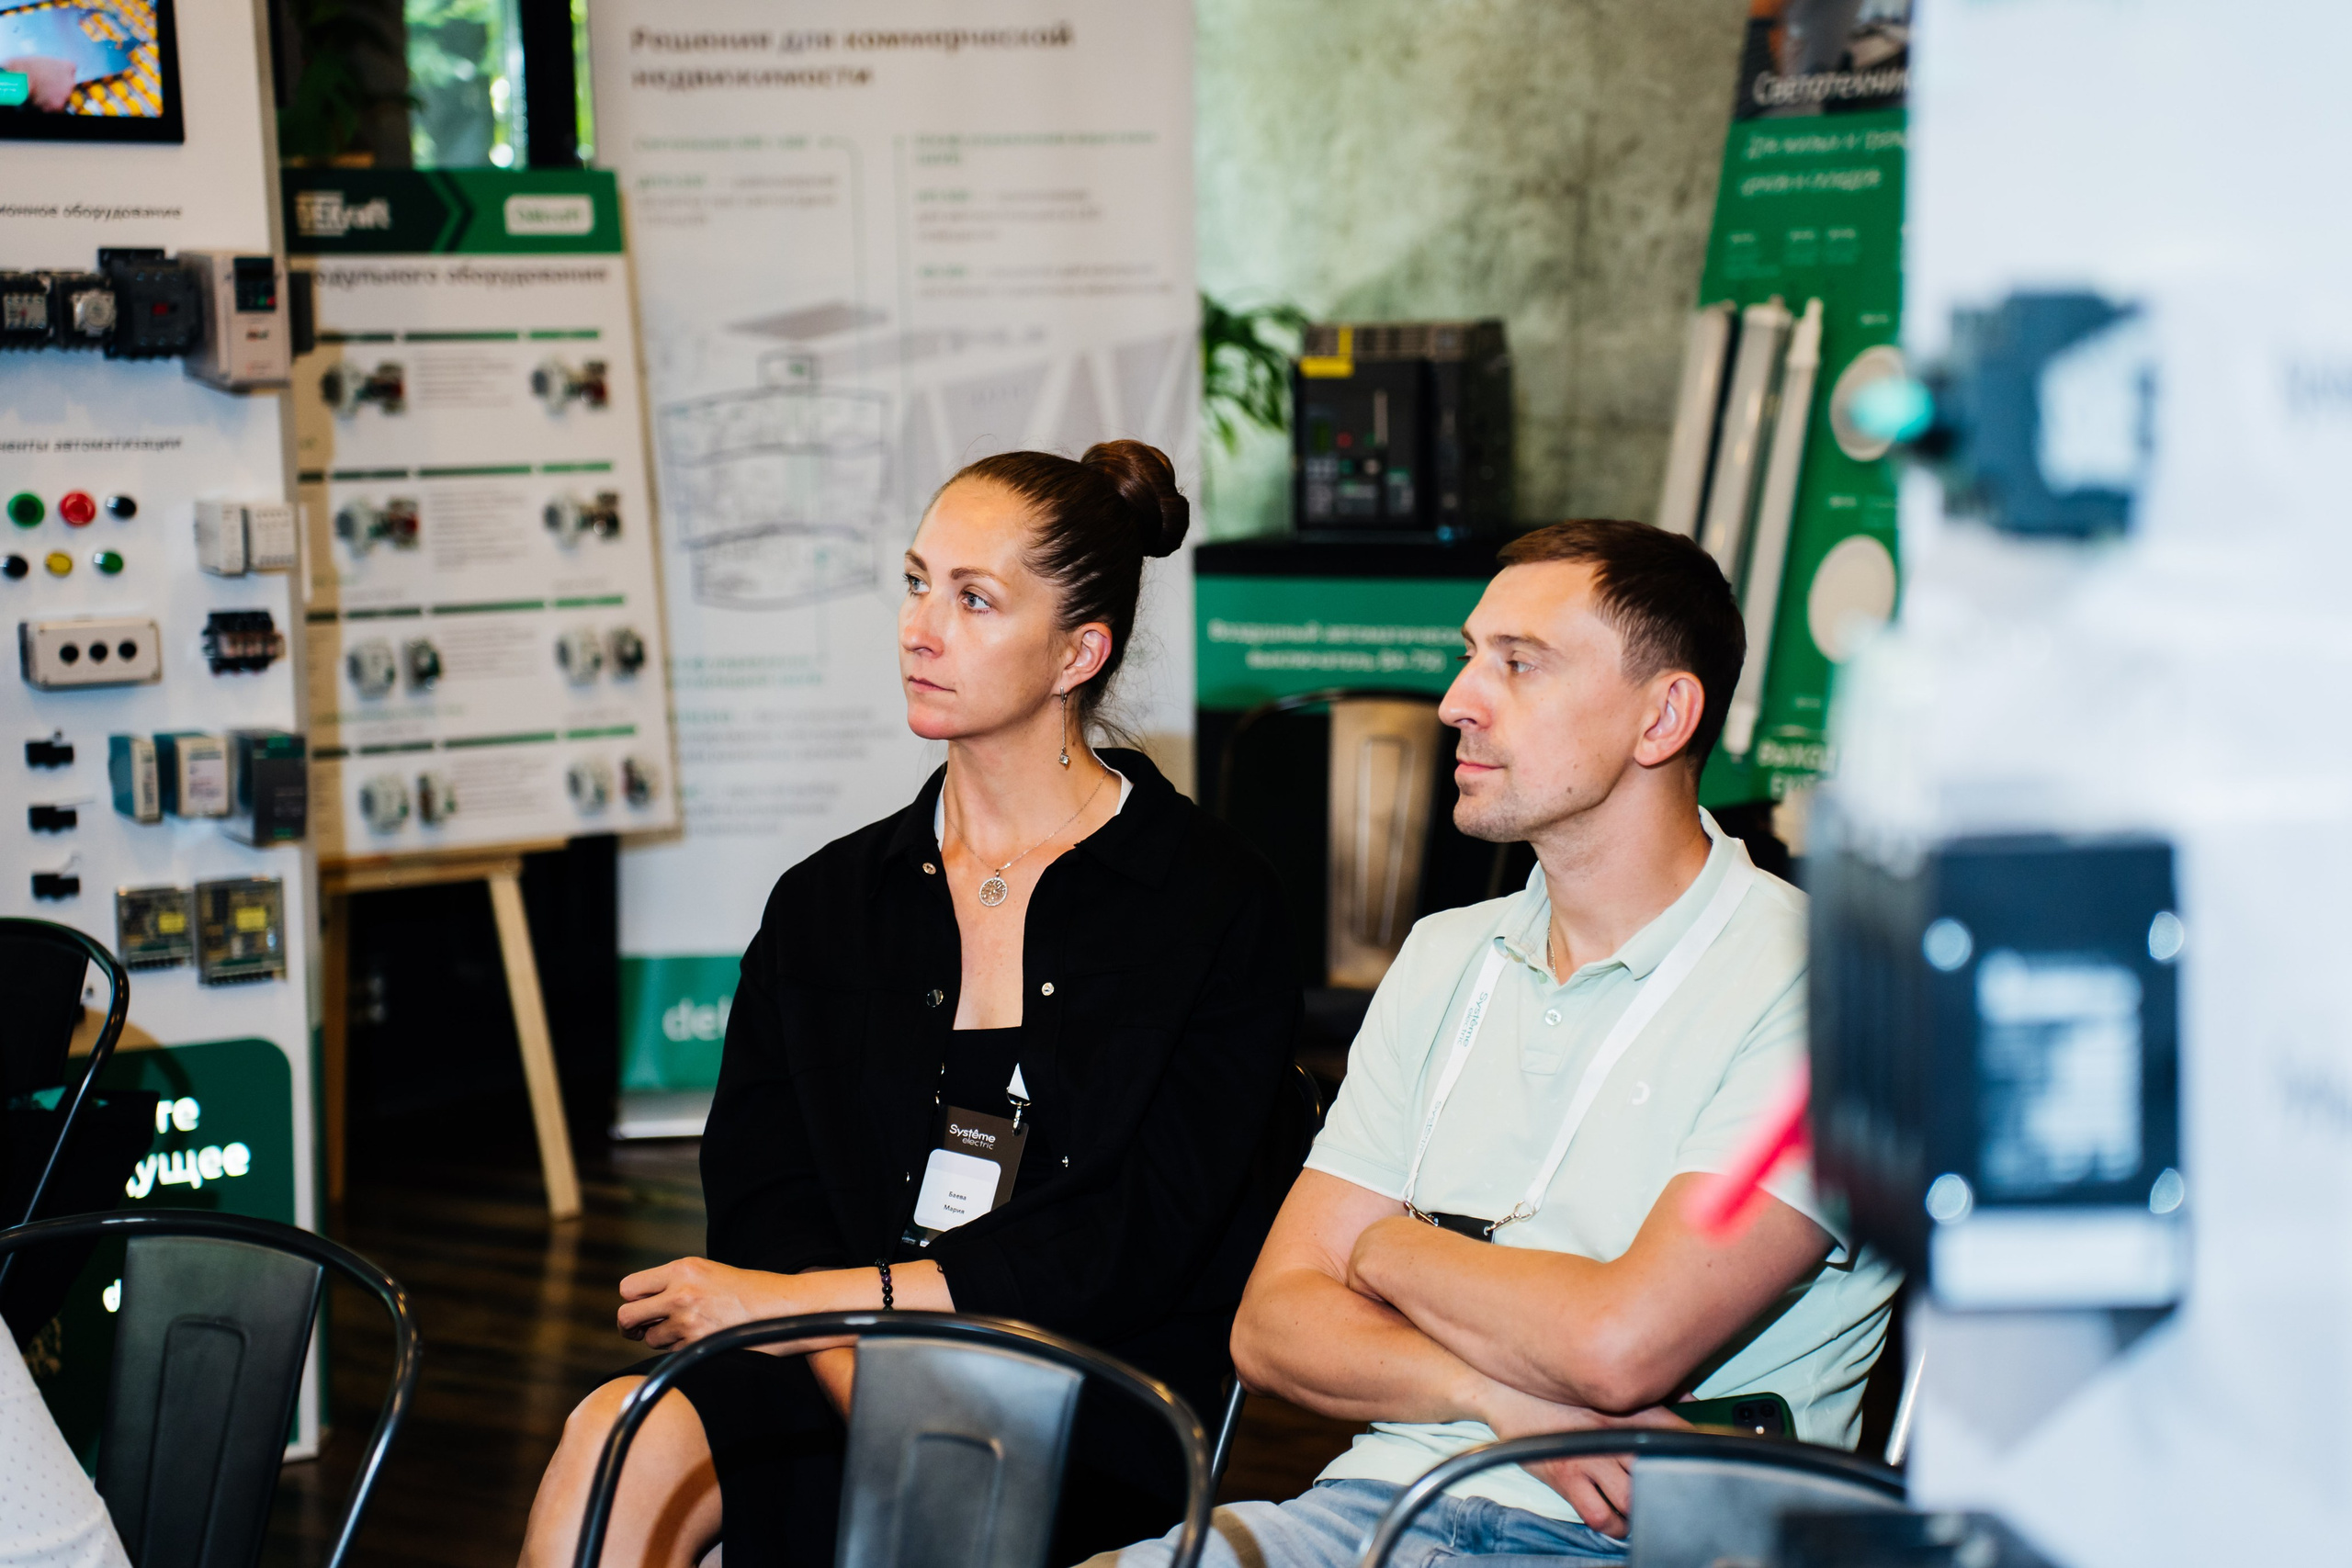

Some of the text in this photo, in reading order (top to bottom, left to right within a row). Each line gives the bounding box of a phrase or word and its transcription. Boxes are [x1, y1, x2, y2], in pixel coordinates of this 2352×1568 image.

[779, 29, 833, 55] для
[62, 200, 183, 221] оборудование
[53, 435, 183, 455] автоматизации
[962, 1137, 994, 1150] electric
[948, 1190, 967, 1201] Баева
[943, 1204, 966, 1214] Мария
